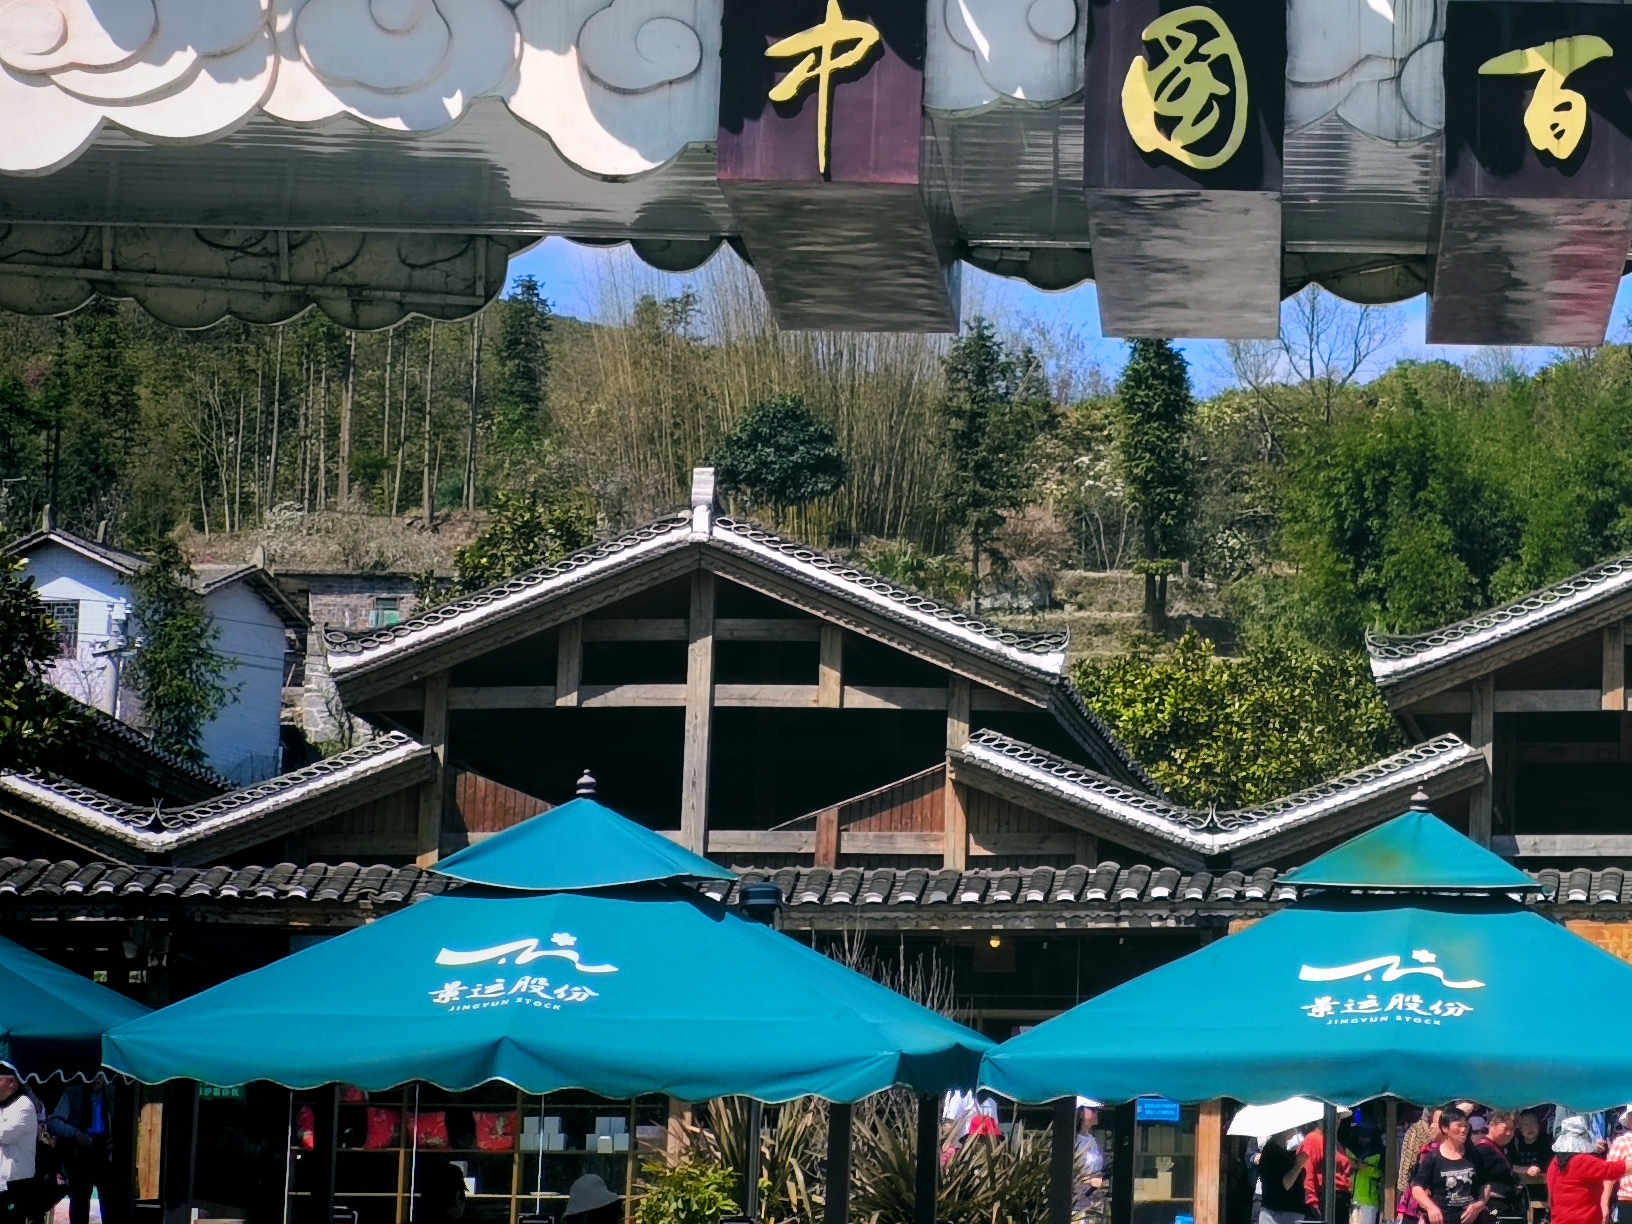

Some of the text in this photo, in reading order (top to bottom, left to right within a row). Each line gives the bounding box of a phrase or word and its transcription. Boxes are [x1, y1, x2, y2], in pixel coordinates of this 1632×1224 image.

[428, 976, 600, 1003] 景运股份
[448, 997, 561, 1012] JINGYUN STOCK
[1301, 993, 1475, 1018] 景运股份
[1326, 1015, 1441, 1026] JINGYUN STOCK
